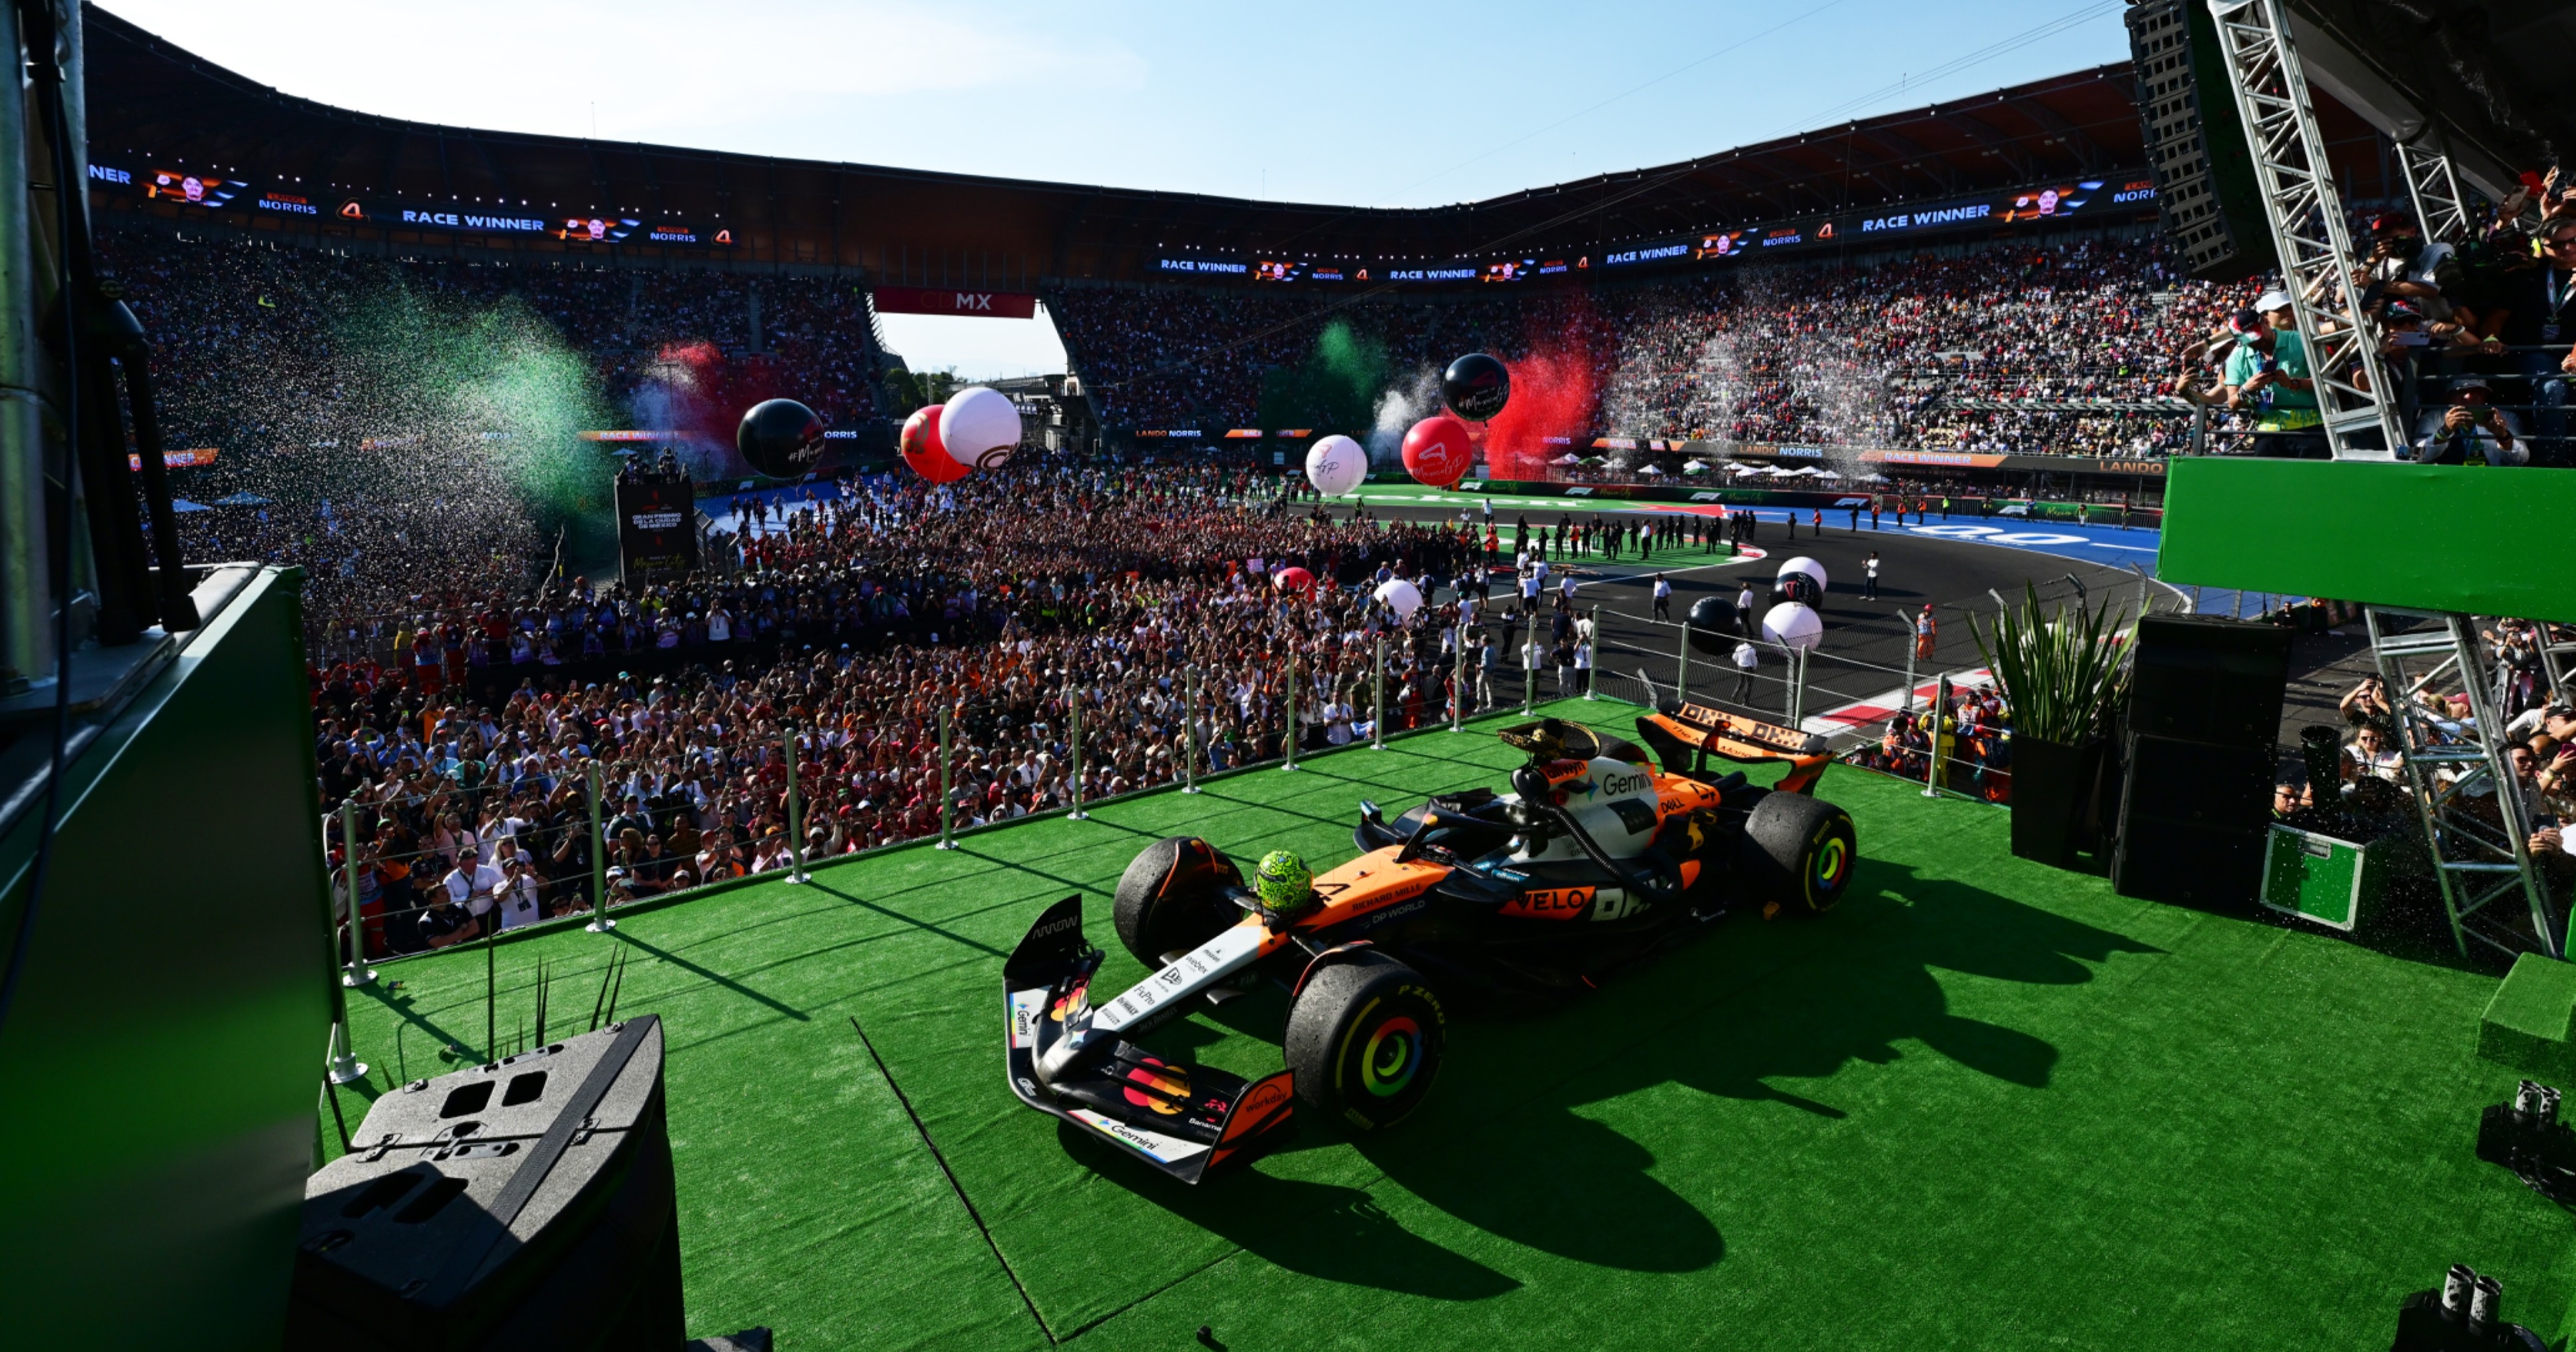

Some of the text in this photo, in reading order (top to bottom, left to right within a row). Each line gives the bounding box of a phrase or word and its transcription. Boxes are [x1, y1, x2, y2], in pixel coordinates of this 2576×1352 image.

[89, 164, 131, 185] NER
[259, 200, 317, 214] NORRIS
[342, 202, 364, 218] 4
[403, 210, 544, 231] RACE WINNER
[1863, 204, 1991, 232] RACE WINNER
[649, 232, 696, 243] NORRIS
[715, 229, 733, 245] 4
[1818, 223, 1833, 240] 4
[1763, 234, 1801, 247] NORRIS
[1578, 256, 1589, 269] 4
[1607, 244, 1688, 264] RACE WINNER
[1161, 259, 1247, 273] RACE WINNER
[1356, 269, 1368, 280] 4
[1390, 269, 1477, 279] RACE WINNER
[1540, 265, 1567, 274] NORRIS
[823, 430, 857, 439] ORRIS
[1739, 444, 1823, 458] LANDO NORRIS
[1884, 452, 1972, 464] RACE WINNER
[2100, 460, 2164, 474] LANDO
[1688, 782, 1716, 802] 4
[1660, 797, 1686, 814] DELL
[1352, 883, 1422, 912] RICHARD MILLE
[1515, 890, 1585, 912] VELO
[1372, 900, 1426, 925] DP WORLD
[1185, 955, 1209, 975] webex
[1133, 985, 1155, 1005] FxPro
[1017, 1010, 1031, 1037] Gemini
[1246, 1091, 1288, 1113] workday
[1111, 1124, 1160, 1151] Gemini
